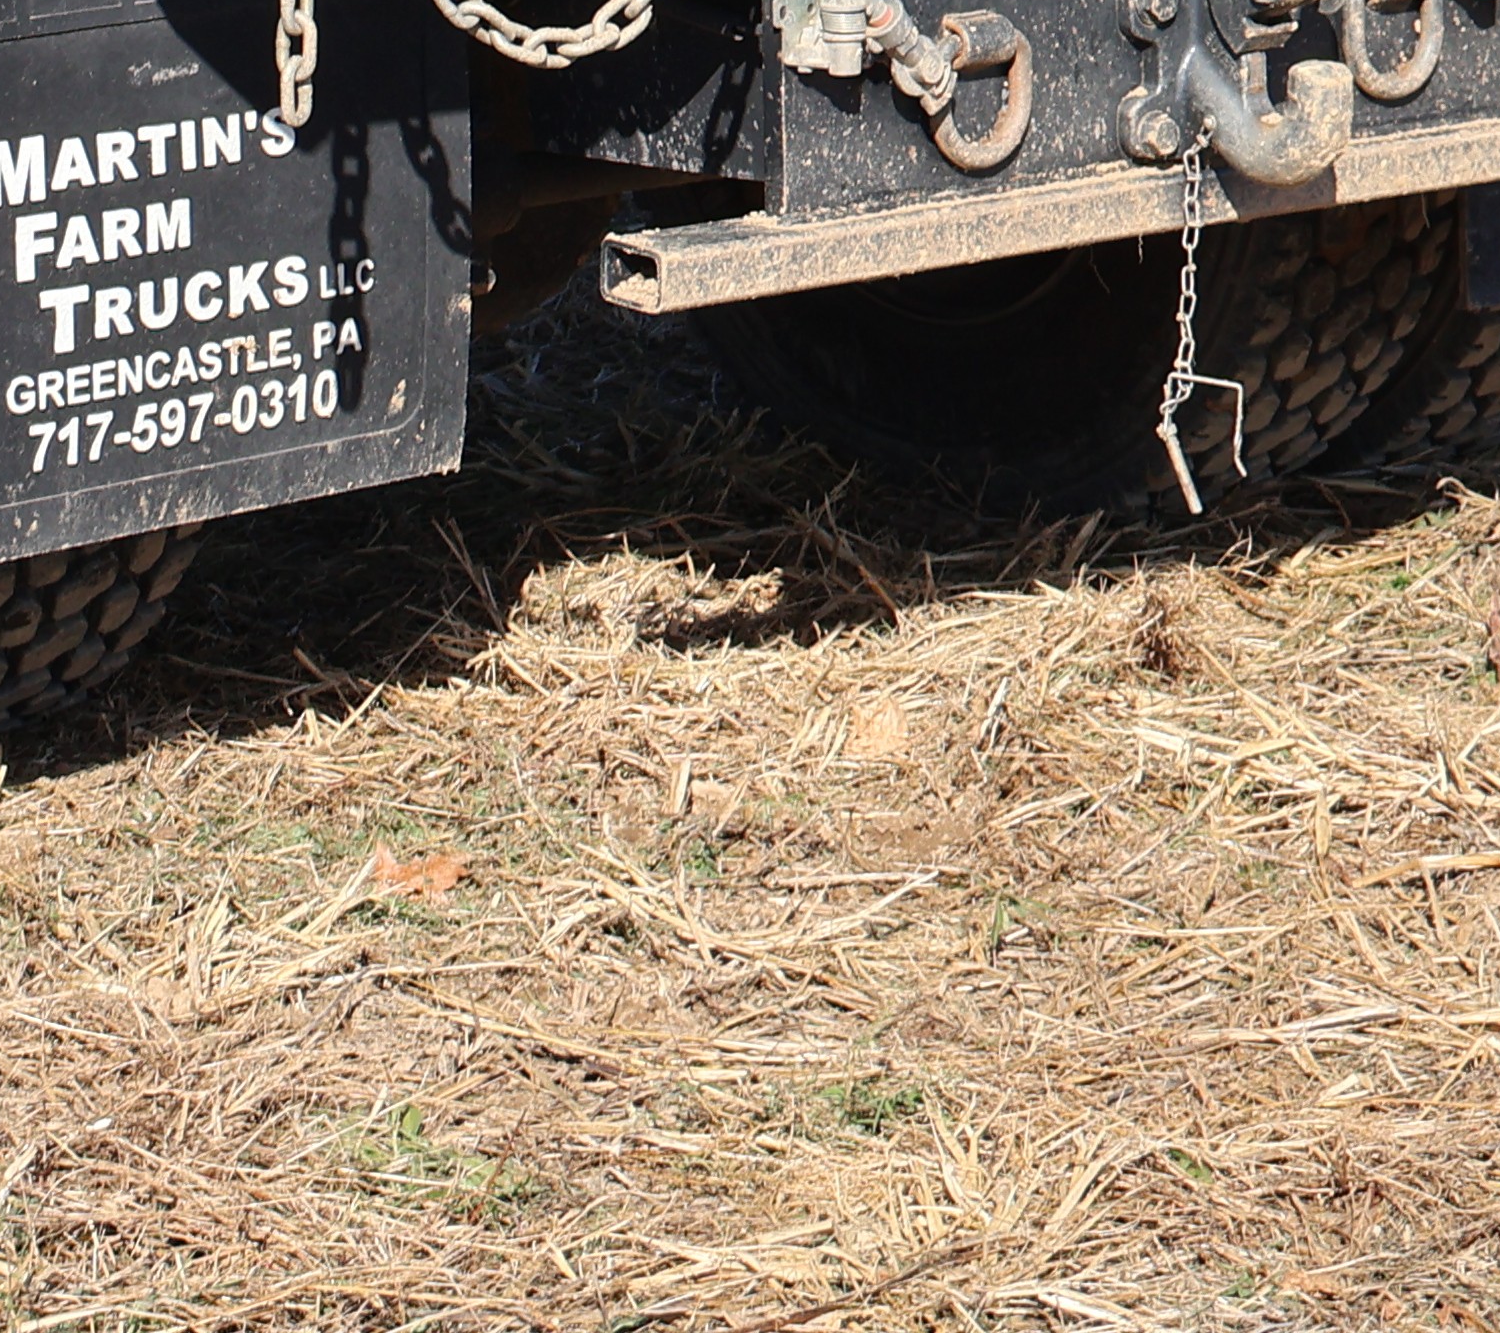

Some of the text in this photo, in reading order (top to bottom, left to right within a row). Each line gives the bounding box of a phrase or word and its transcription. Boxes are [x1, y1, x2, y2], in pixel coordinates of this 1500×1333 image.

[14, 197, 193, 284] FARM
[39, 255, 377, 356] TRUCKS LLC
[5, 317, 364, 416] GREENCASTLE, PA
[28, 369, 340, 474] 717-597-0310
